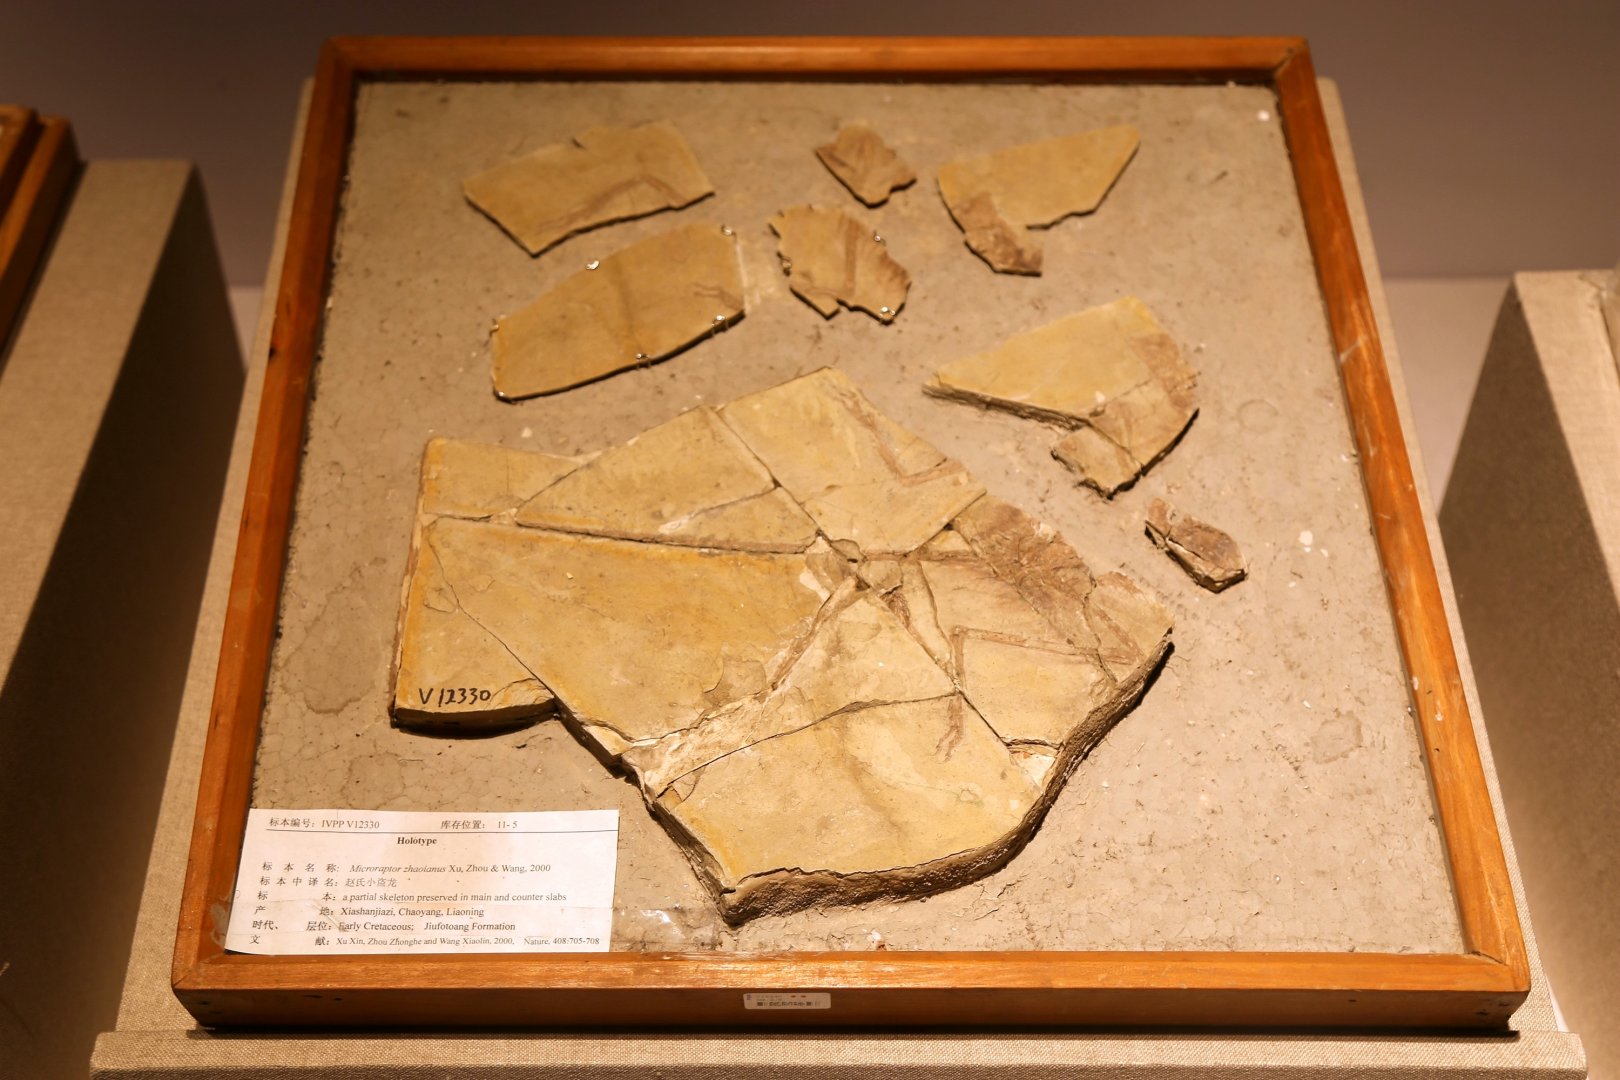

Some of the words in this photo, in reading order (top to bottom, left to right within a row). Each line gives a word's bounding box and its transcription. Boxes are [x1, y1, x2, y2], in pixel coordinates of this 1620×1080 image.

[322, 819, 345, 828] IVPP
[347, 820, 380, 829] V12330
[396, 836, 437, 846] Holotype
[350, 864, 401, 874] Microraptor
[402, 864, 446, 874] zhaoianus
[448, 864, 464, 873] Xu,
[466, 864, 489, 872] Zhou
[490, 864, 499, 872] &
[502, 864, 528, 874] Wang,
[530, 864, 551, 872] 2000
[350, 893, 377, 902] partial
[379, 893, 414, 902] skeleton
[417, 893, 457, 903] preserved
[460, 893, 468, 901] in
[471, 893, 491, 901] main
[494, 893, 510, 901] and
[512, 893, 543, 901] counter
[545, 893, 567, 901] slabs
[340, 908, 396, 917] Xiashanjiazi,
[399, 907, 444, 917] Chaoyang,
[446, 908, 484, 917] Liaoning
[338, 923, 361, 932] Early
[363, 922, 414, 931] Cretaceous;
[472, 922, 516, 930] Formation
[368, 937, 387, 946] Zhou
[389, 936, 422, 947] Zhonghe
[440, 938, 460, 947] Wang
